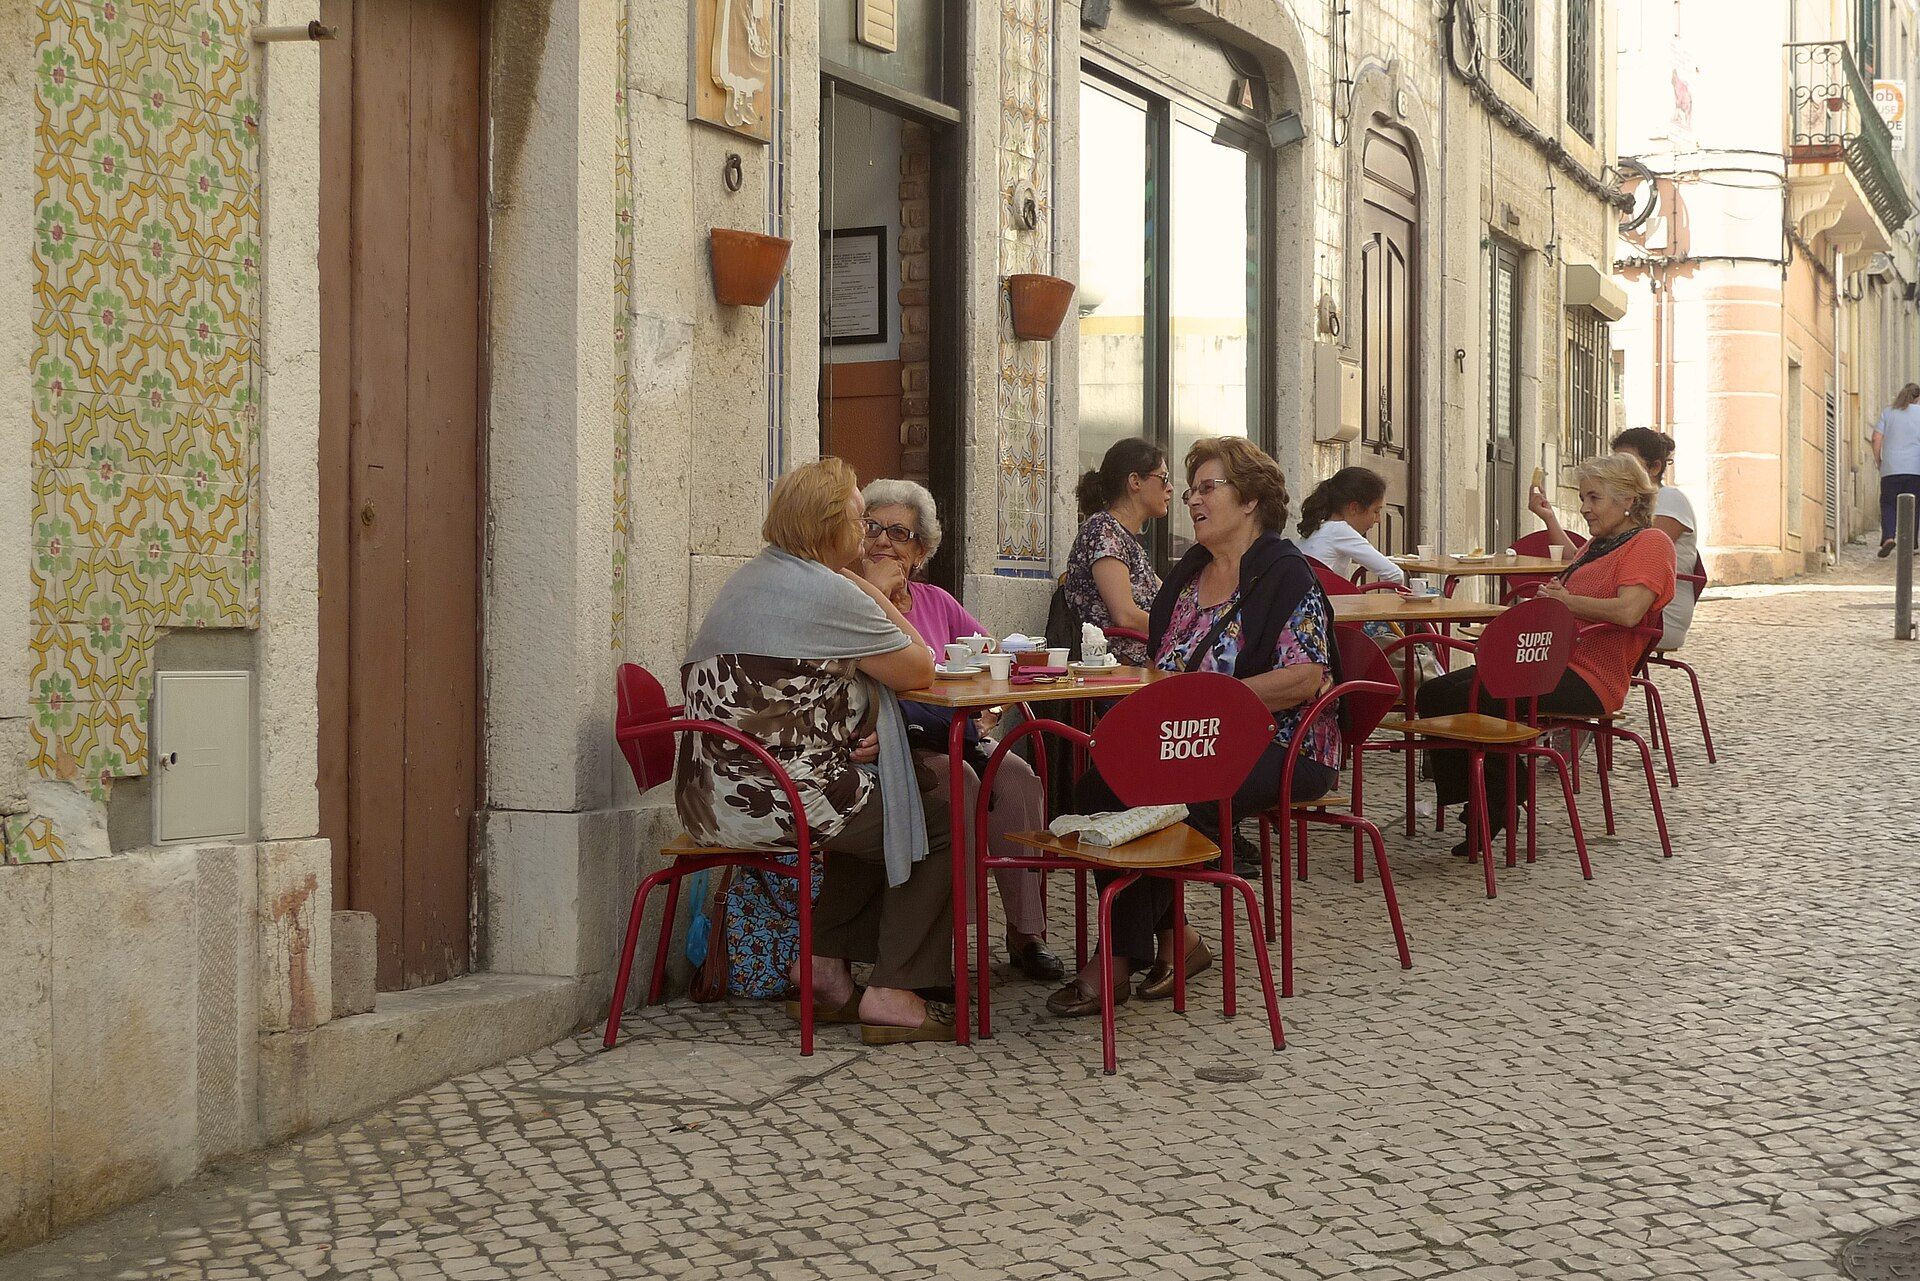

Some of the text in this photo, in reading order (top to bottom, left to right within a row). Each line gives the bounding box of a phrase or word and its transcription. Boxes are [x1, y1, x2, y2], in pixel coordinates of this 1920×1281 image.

[1516, 631, 1553, 648] SUPER
[1515, 646, 1550, 663] BOCK
[1159, 717, 1221, 740] SUPER
[1160, 737, 1217, 760] BOCK
